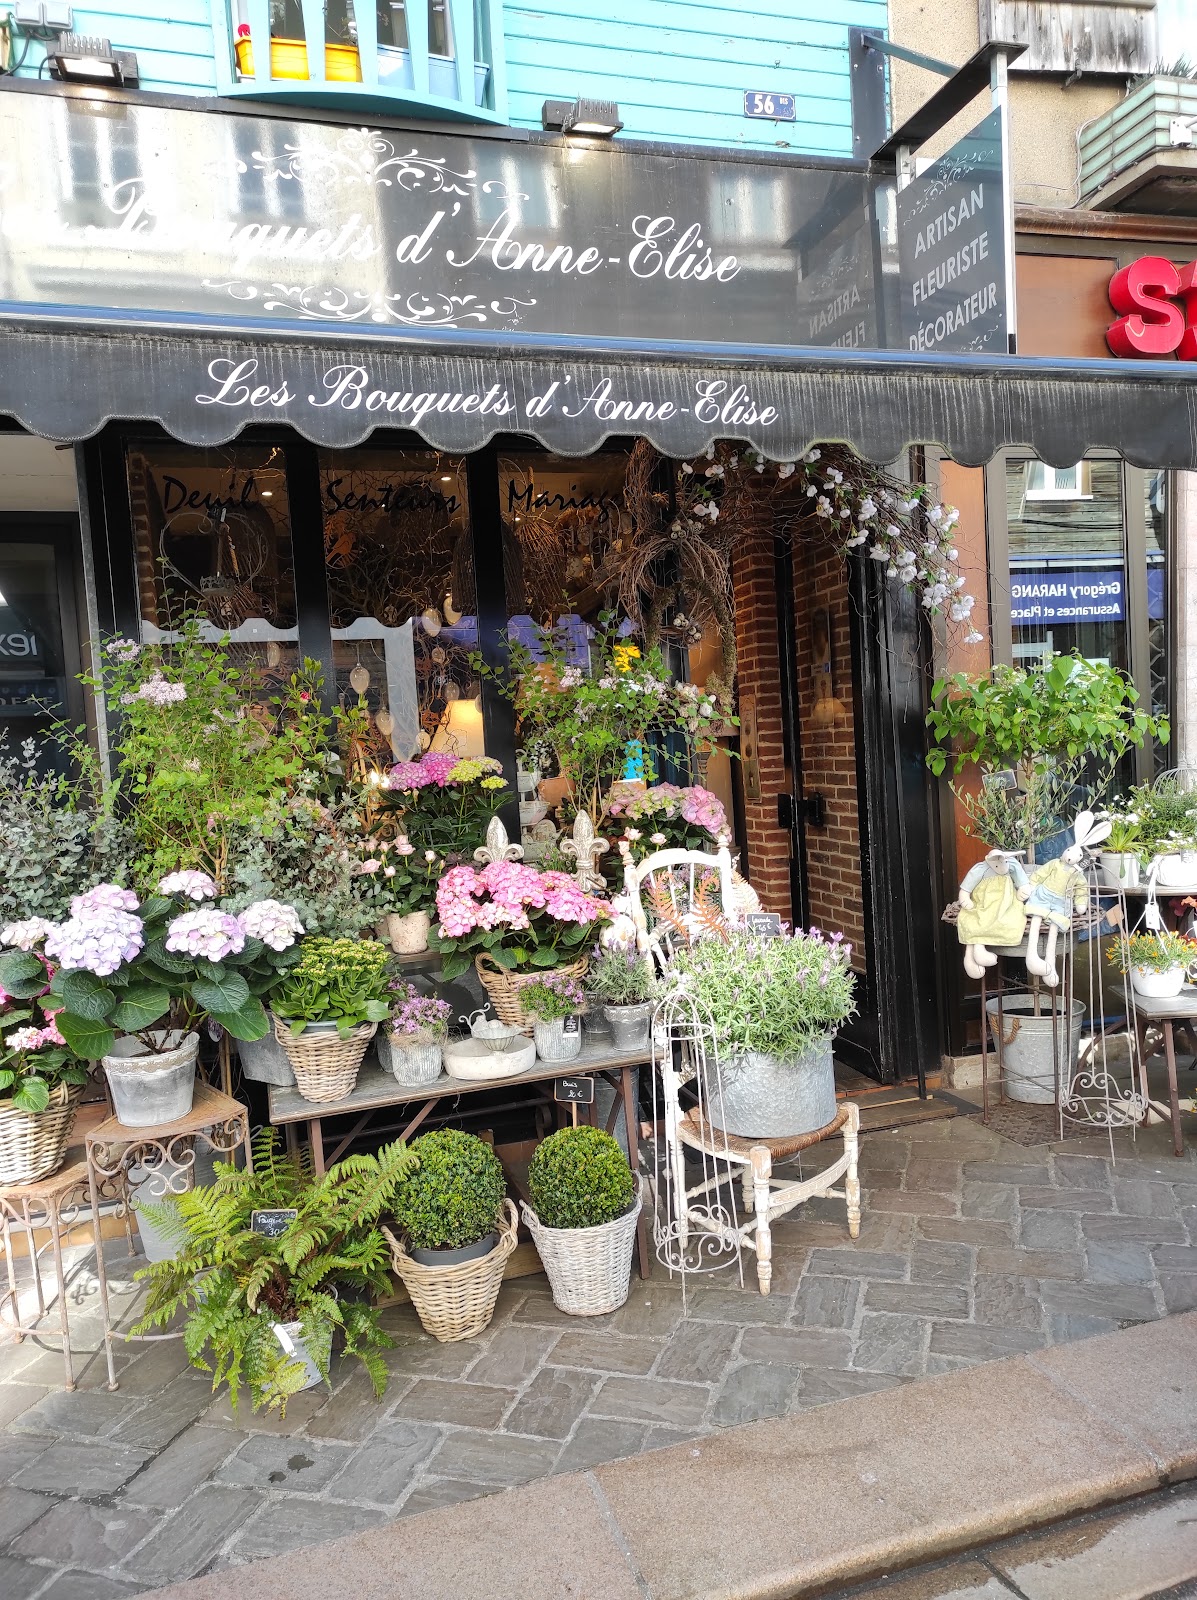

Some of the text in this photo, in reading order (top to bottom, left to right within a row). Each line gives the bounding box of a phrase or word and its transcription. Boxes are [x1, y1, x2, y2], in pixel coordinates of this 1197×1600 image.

[754, 94, 775, 114] 56
[914, 183, 984, 260] ARTISAN
[912, 231, 989, 307] FLEURISTE
[909, 282, 997, 351] DÉCORATEUR
[195, 358, 780, 427] Les Bouquets d'Anne-Elise
[162, 475, 257, 514] Deuil
[321, 478, 462, 515] Senteurs
